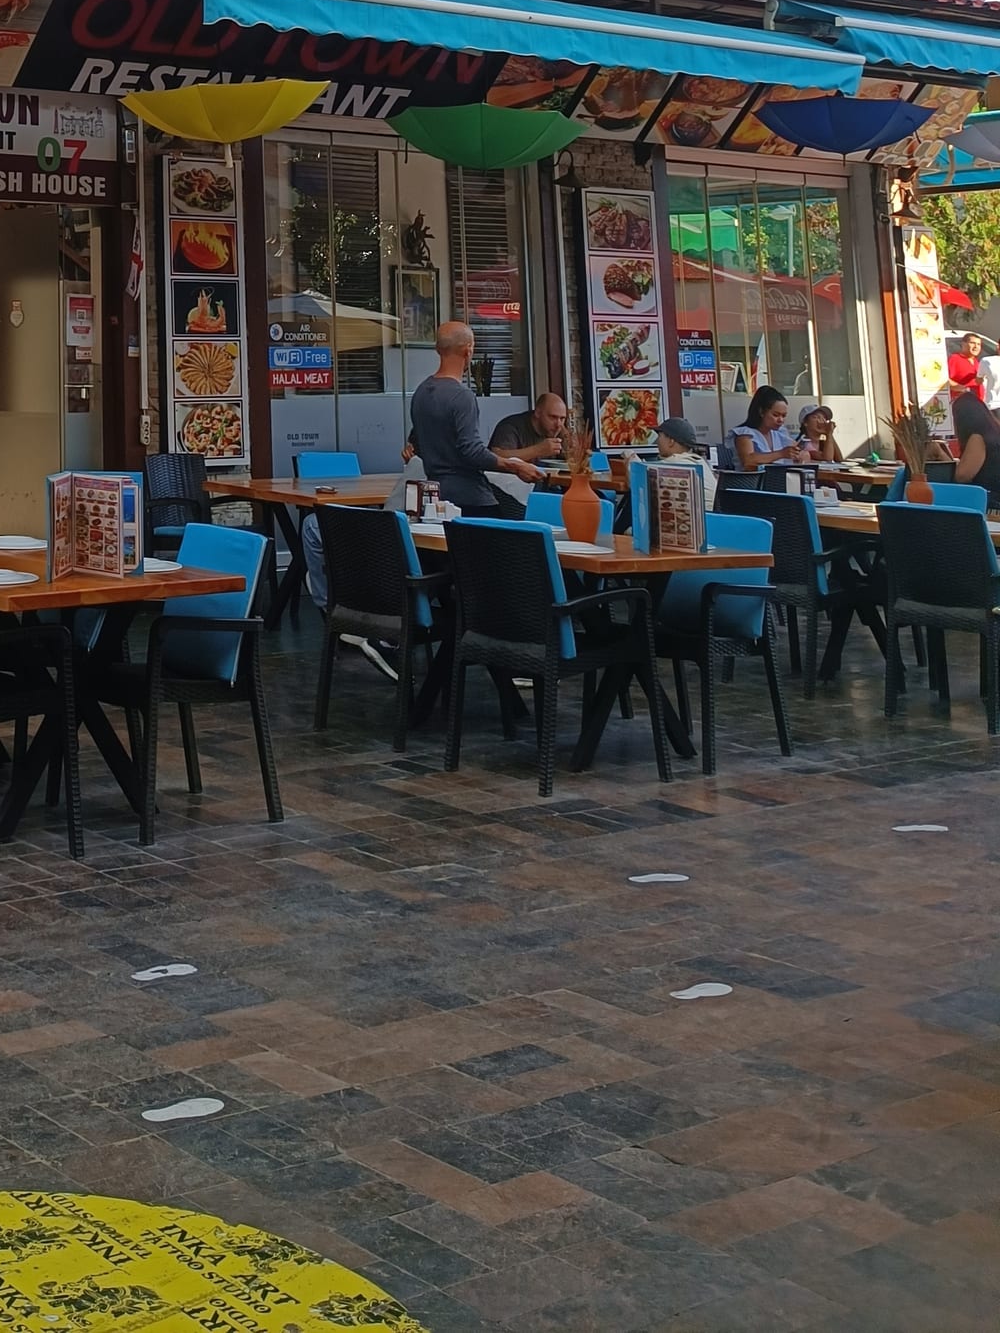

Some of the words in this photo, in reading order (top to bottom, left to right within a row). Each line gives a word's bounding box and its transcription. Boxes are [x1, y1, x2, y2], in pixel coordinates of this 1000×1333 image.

[37, 136, 88, 174] 07
[31, 173, 106, 197] HOUSE
[284, 333, 327, 341] CONDITIONER
[300, 324, 310, 332] AIR
[305, 351, 327, 363] Free
[695, 354, 712, 365] Free
[272, 373, 302, 384] HALAL
[304, 373, 329, 384] MEAT
[681, 374, 694, 384] LAL
[695, 373, 714, 384] MEAT
[11, 1192, 62, 1217] ART
[67, 1224, 136, 1266] INKA
[91, 1220, 152, 1260] TATTOO
[140, 1230, 204, 1270] TATTOO
[201, 1271, 272, 1313] STUDIO
[157, 1223, 227, 1267] INKA
[231, 1274, 301, 1305] ART
